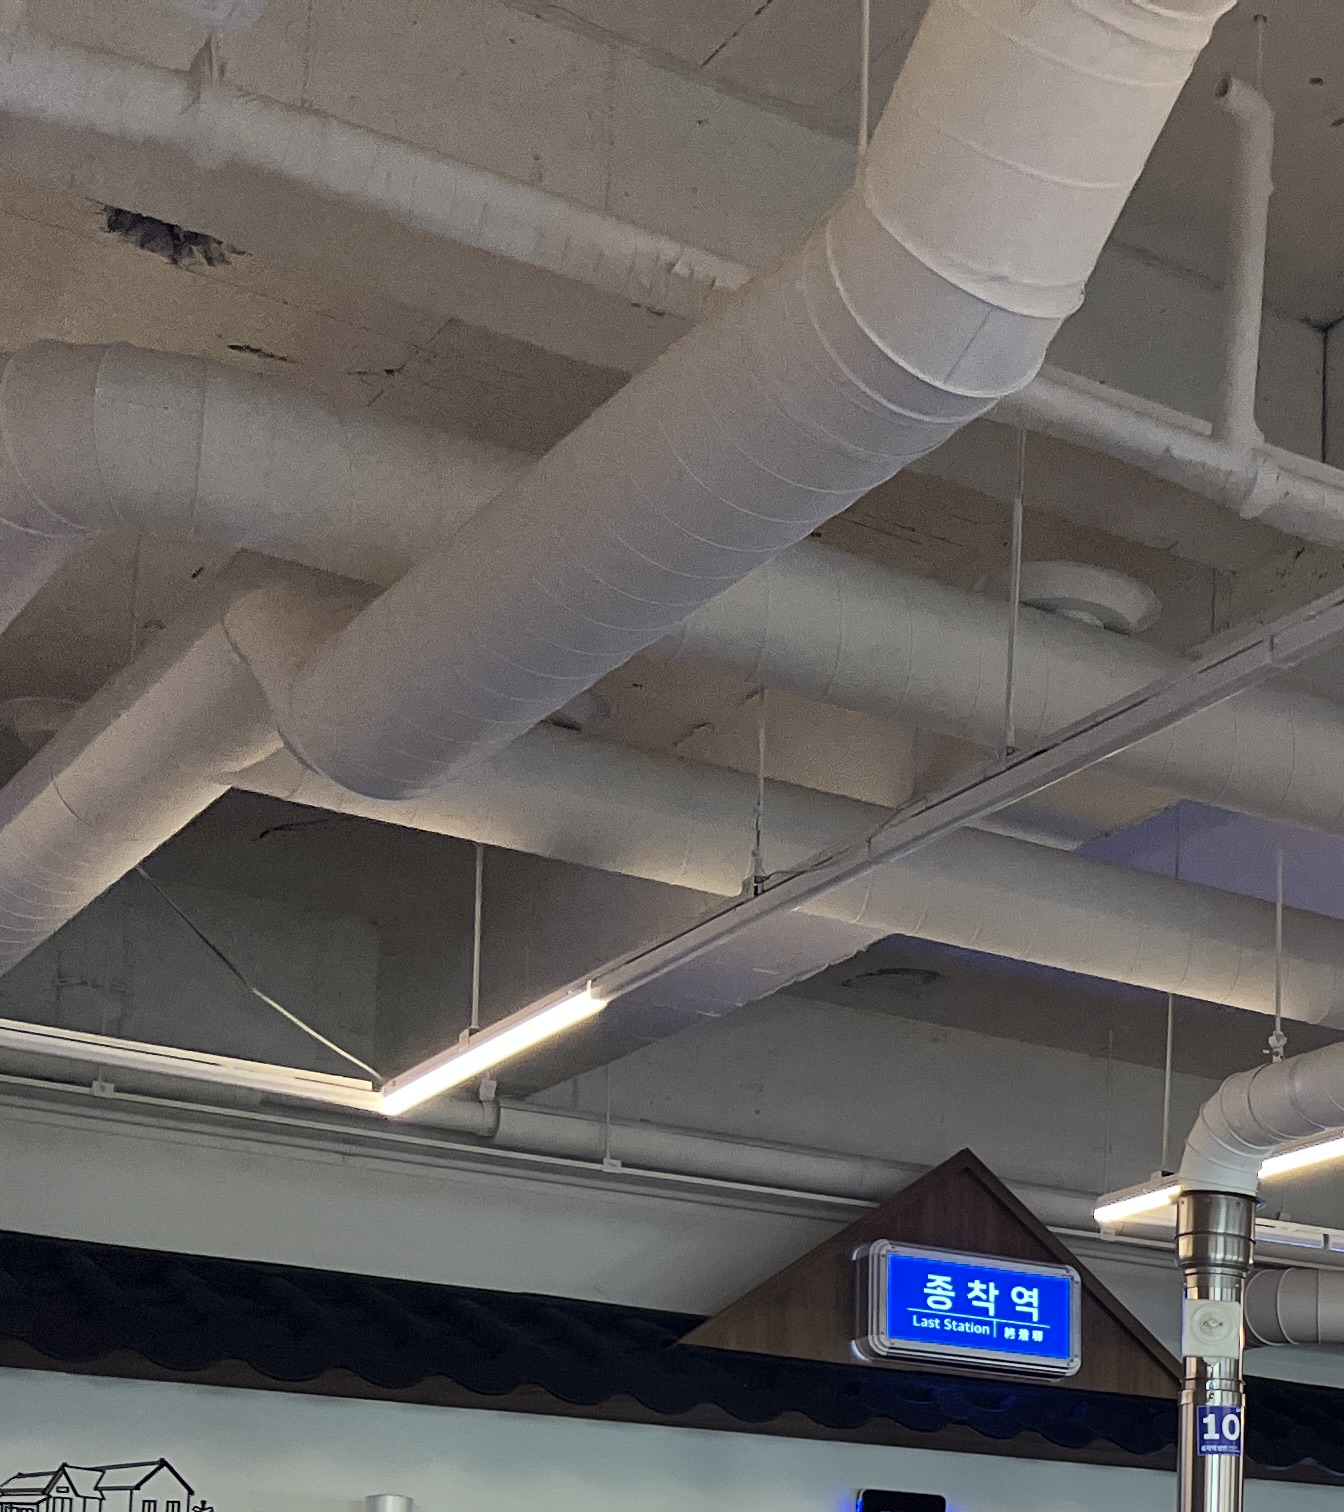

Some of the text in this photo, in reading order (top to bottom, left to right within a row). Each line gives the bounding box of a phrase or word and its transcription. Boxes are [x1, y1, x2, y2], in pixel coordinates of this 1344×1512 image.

[923, 1273, 1039, 1323] 종착역
[912, 1314, 990, 1336] Last Station
[1202, 1413, 1240, 1441] 10
